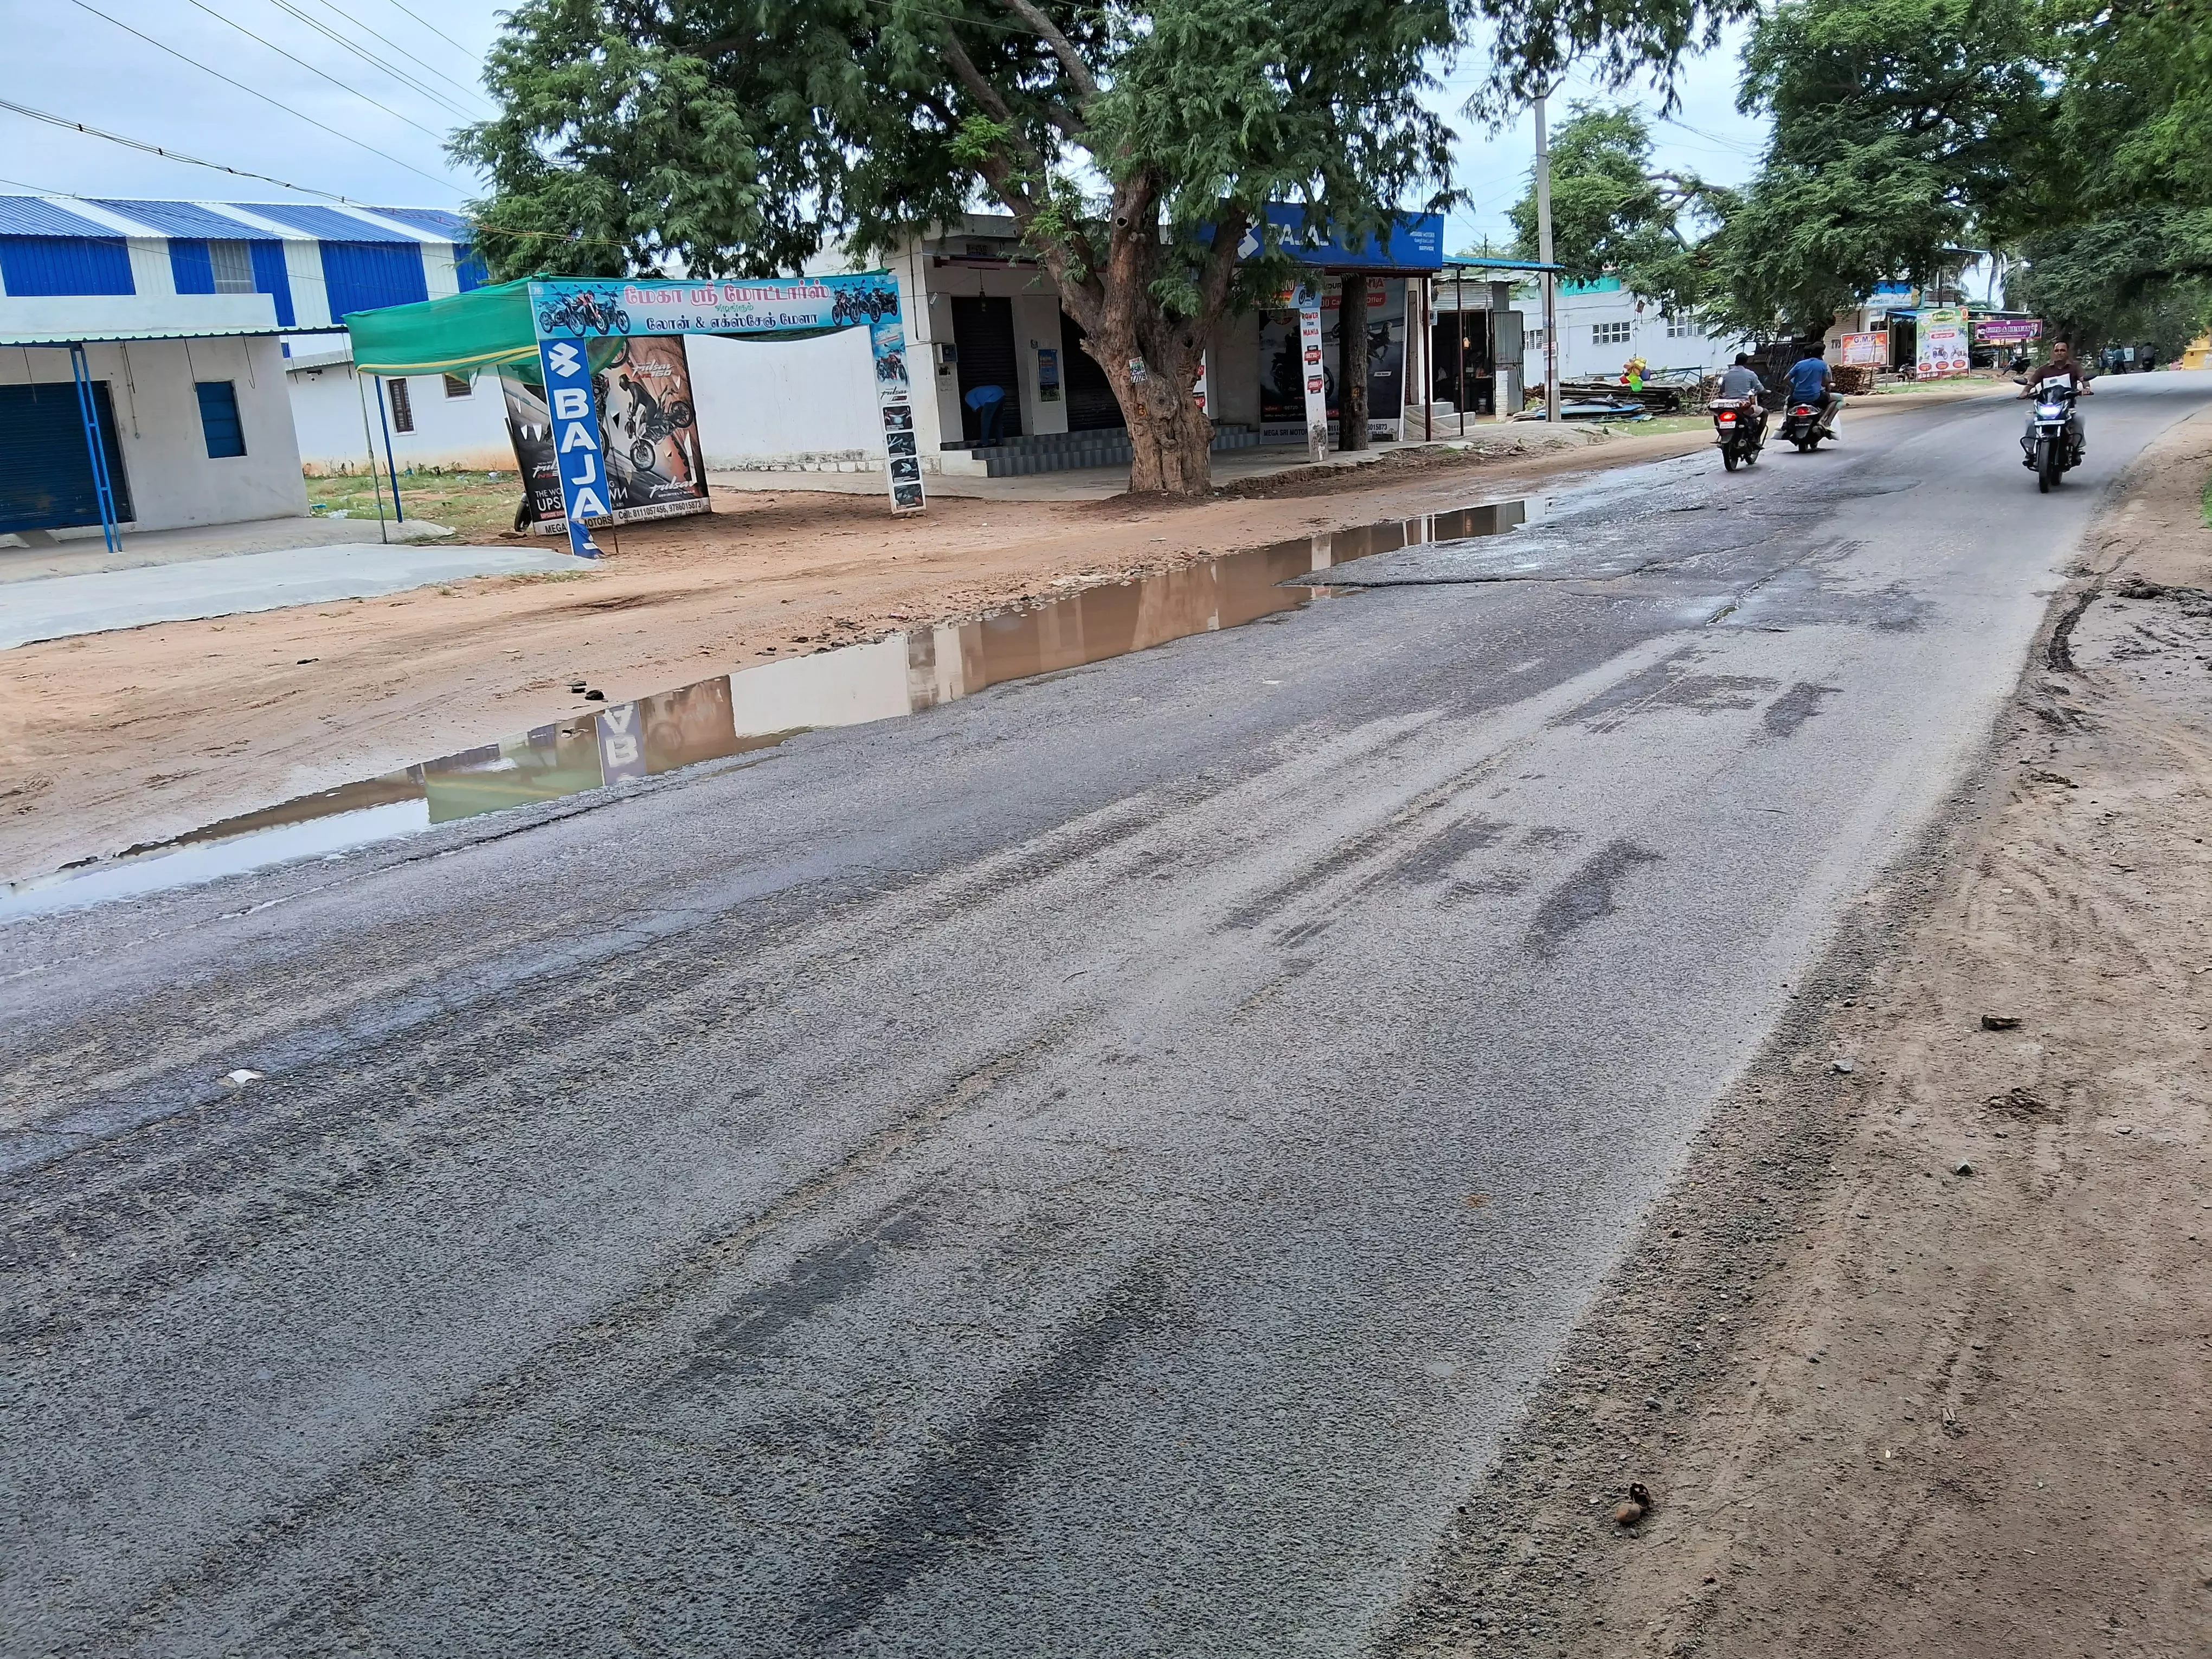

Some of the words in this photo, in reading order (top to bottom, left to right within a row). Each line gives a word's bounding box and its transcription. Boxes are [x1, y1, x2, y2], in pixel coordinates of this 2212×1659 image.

[1267, 223, 1331, 247] AAJ
[625, 285, 683, 304] மேகா
[647, 315, 690, 330] லோன்
[696, 317, 705, 329] &
[780, 313, 818, 325] மேளா
[535, 490, 548, 498] THE
[537, 497, 565, 511] UPSI
[619, 509, 632, 519] Cell:
[545, 523, 567, 534] MEGA
